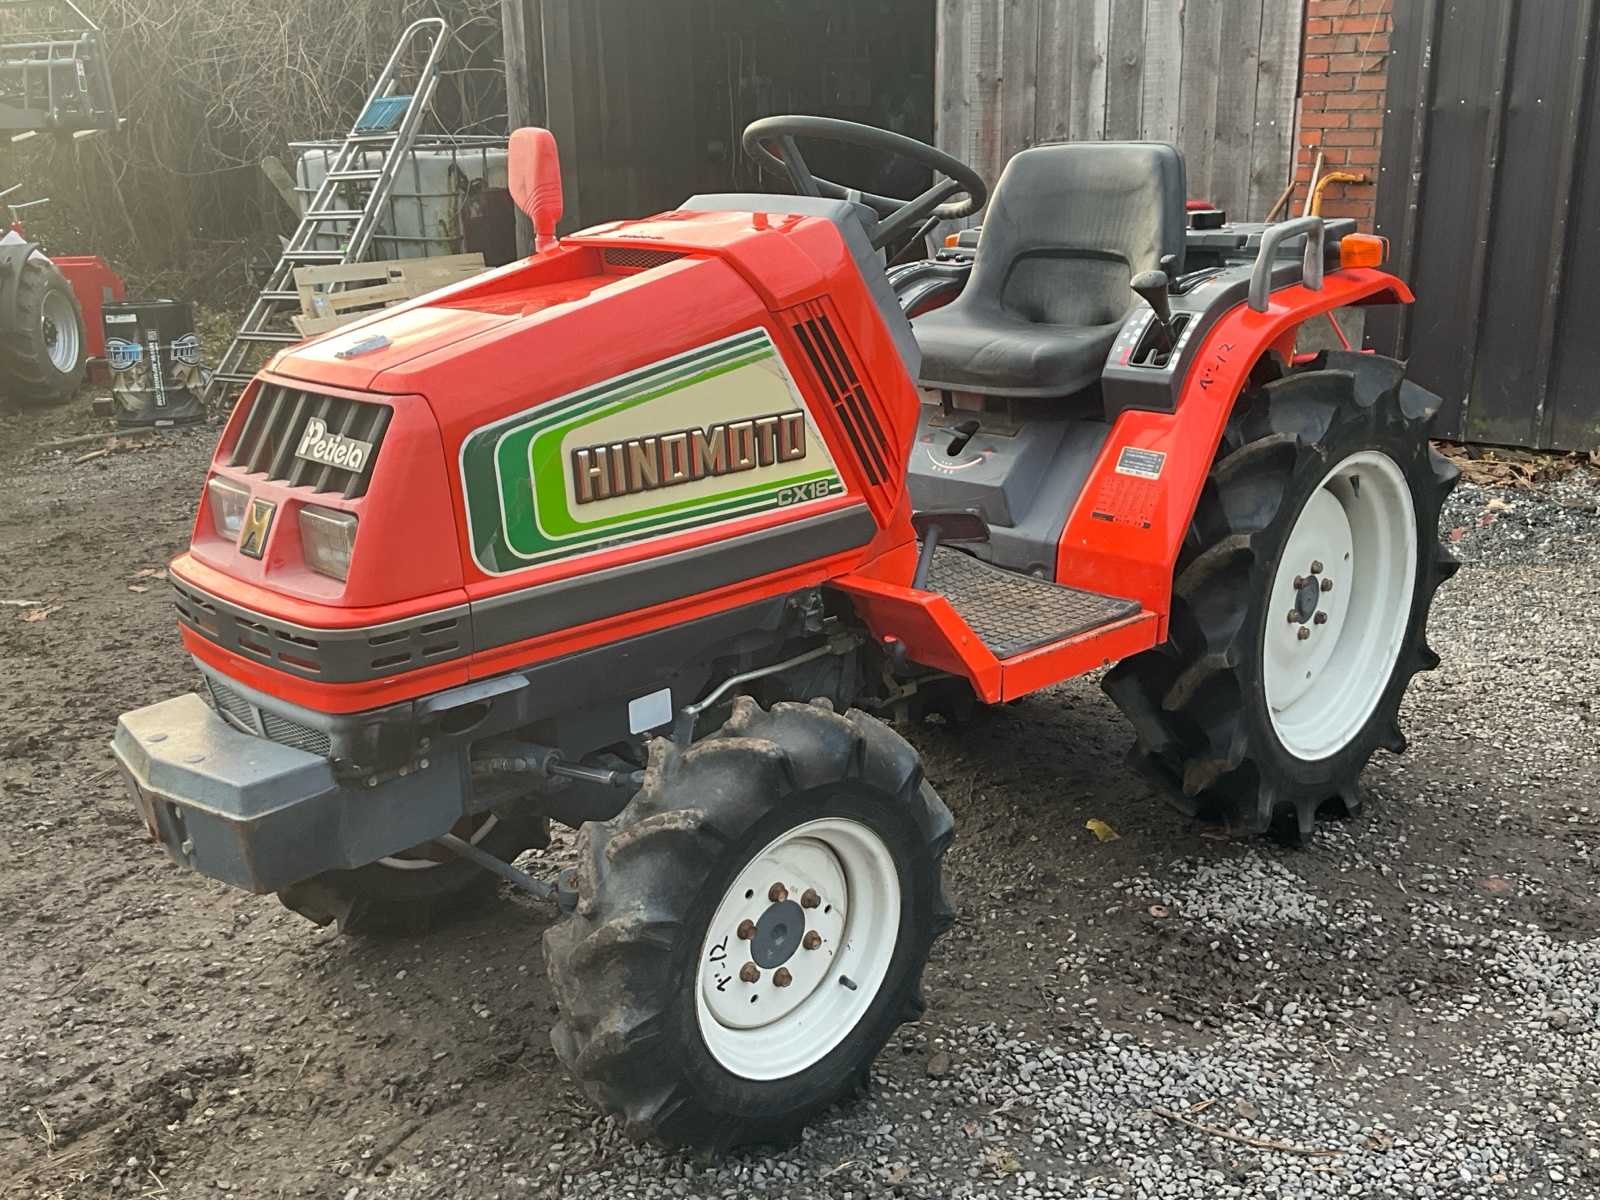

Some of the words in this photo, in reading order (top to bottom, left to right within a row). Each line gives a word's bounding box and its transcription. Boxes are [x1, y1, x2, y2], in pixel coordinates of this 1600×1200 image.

[300, 421, 363, 468] Petiela
[572, 409, 806, 504] HINOMOTO
[777, 481, 829, 506] CX18
